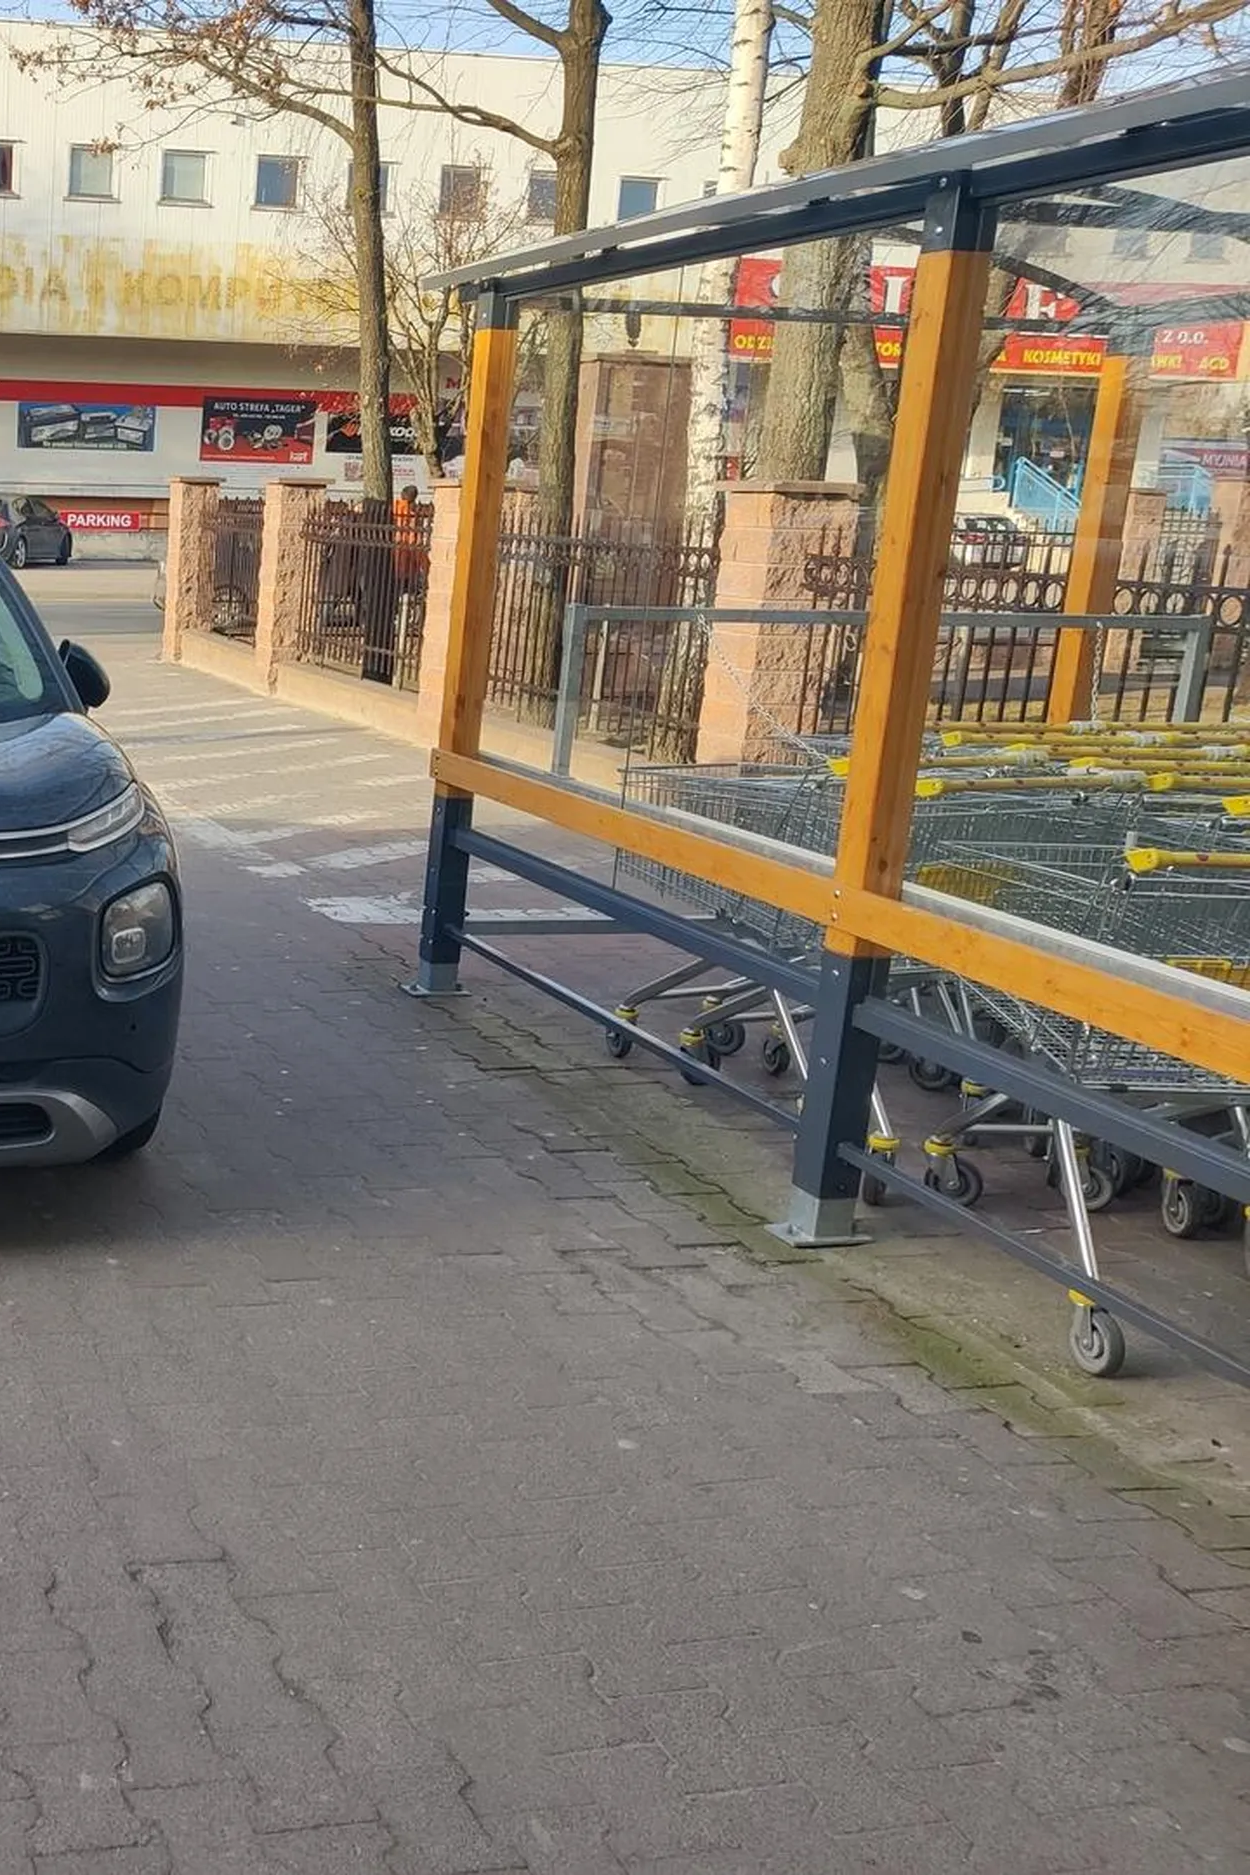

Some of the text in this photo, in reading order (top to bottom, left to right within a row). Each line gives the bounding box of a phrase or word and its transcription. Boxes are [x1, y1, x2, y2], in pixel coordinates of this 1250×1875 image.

[1022, 349, 1101, 366] KOSMETYKI
[214, 402, 238, 411] AUTO
[239, 402, 270, 412] STREFA
[67, 514, 132, 528] PARKING
